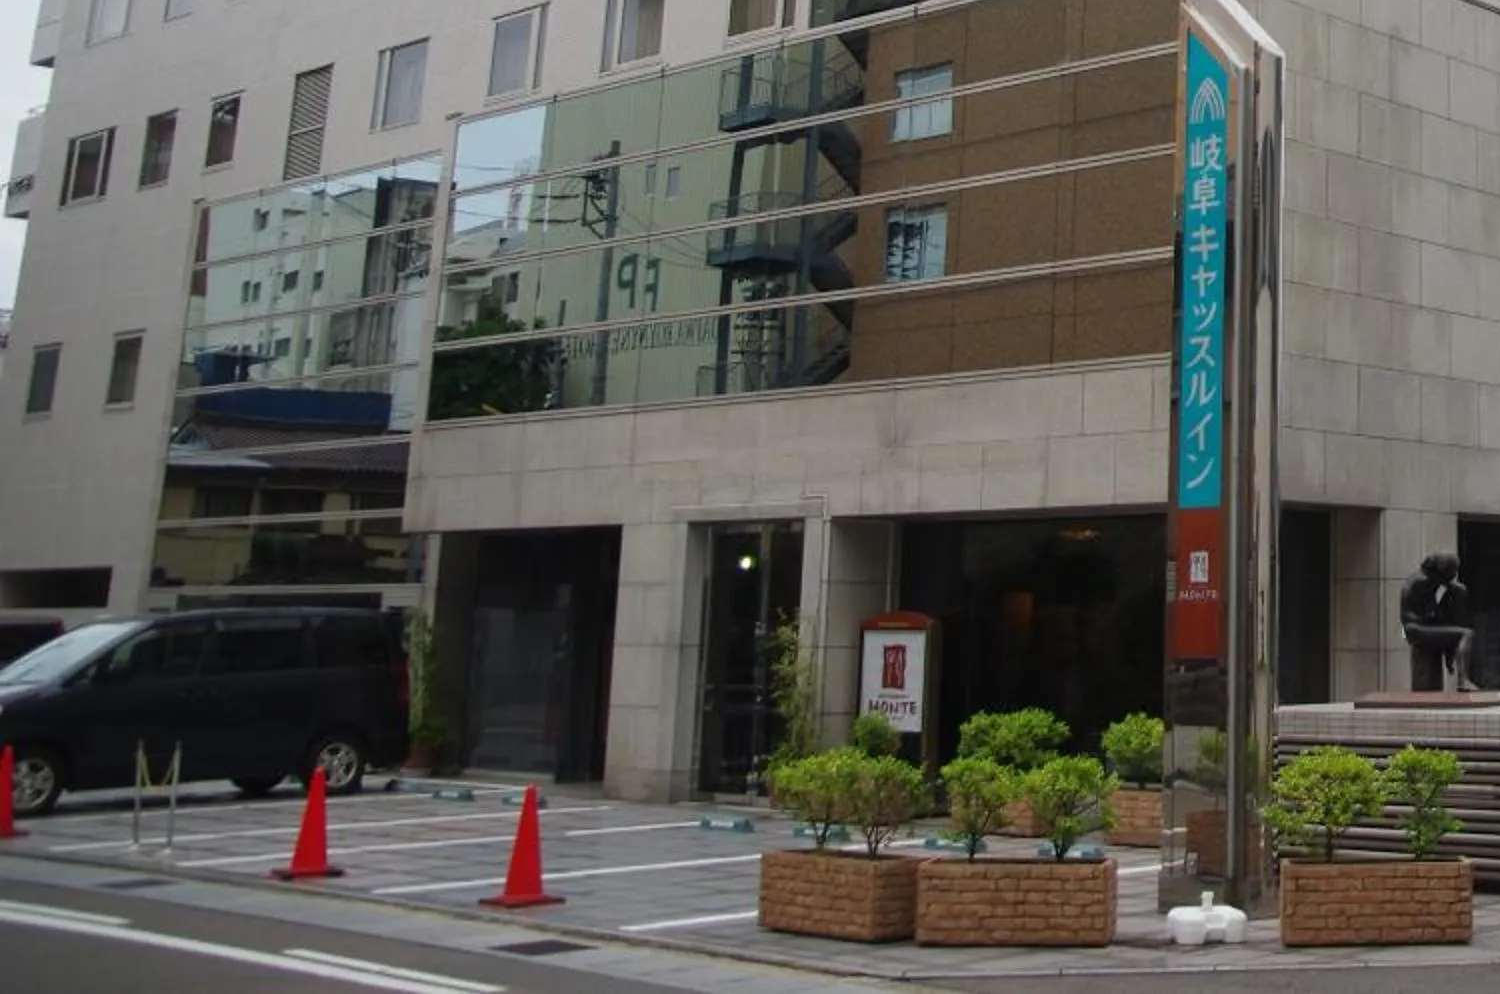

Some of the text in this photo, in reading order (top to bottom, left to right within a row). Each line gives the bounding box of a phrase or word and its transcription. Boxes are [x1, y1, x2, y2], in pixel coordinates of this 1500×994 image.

[1186, 132, 1223, 490] 岐阜キャッスルイン
[868, 699, 917, 715] MONTE
